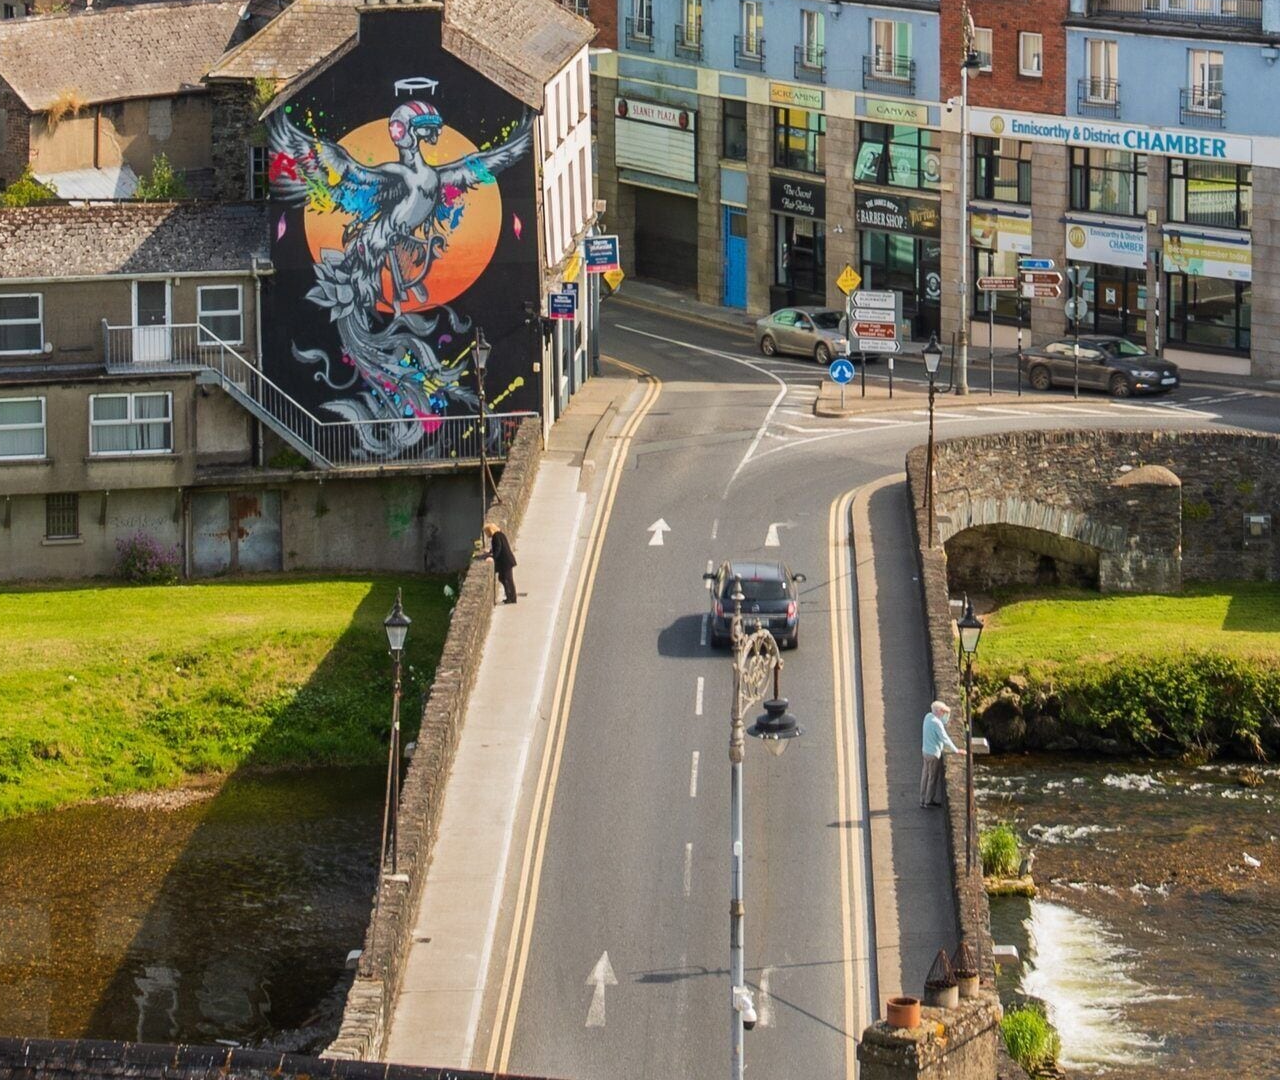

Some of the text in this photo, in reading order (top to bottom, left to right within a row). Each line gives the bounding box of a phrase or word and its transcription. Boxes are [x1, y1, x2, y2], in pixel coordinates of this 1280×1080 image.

[771, 88, 821, 104] SCREAMING
[633, 104, 676, 122] SLANEY PLAZA
[876, 105, 918, 118] CANVAS
[1011, 119, 1227, 158] Enniscorthy & District CHAMBER
[861, 210, 904, 229] BARBER SHOP
[1090, 228, 1120, 240] Enniscorthy
[1125, 232, 1144, 242] District
[1109, 239, 1145, 252] CHAMBER
